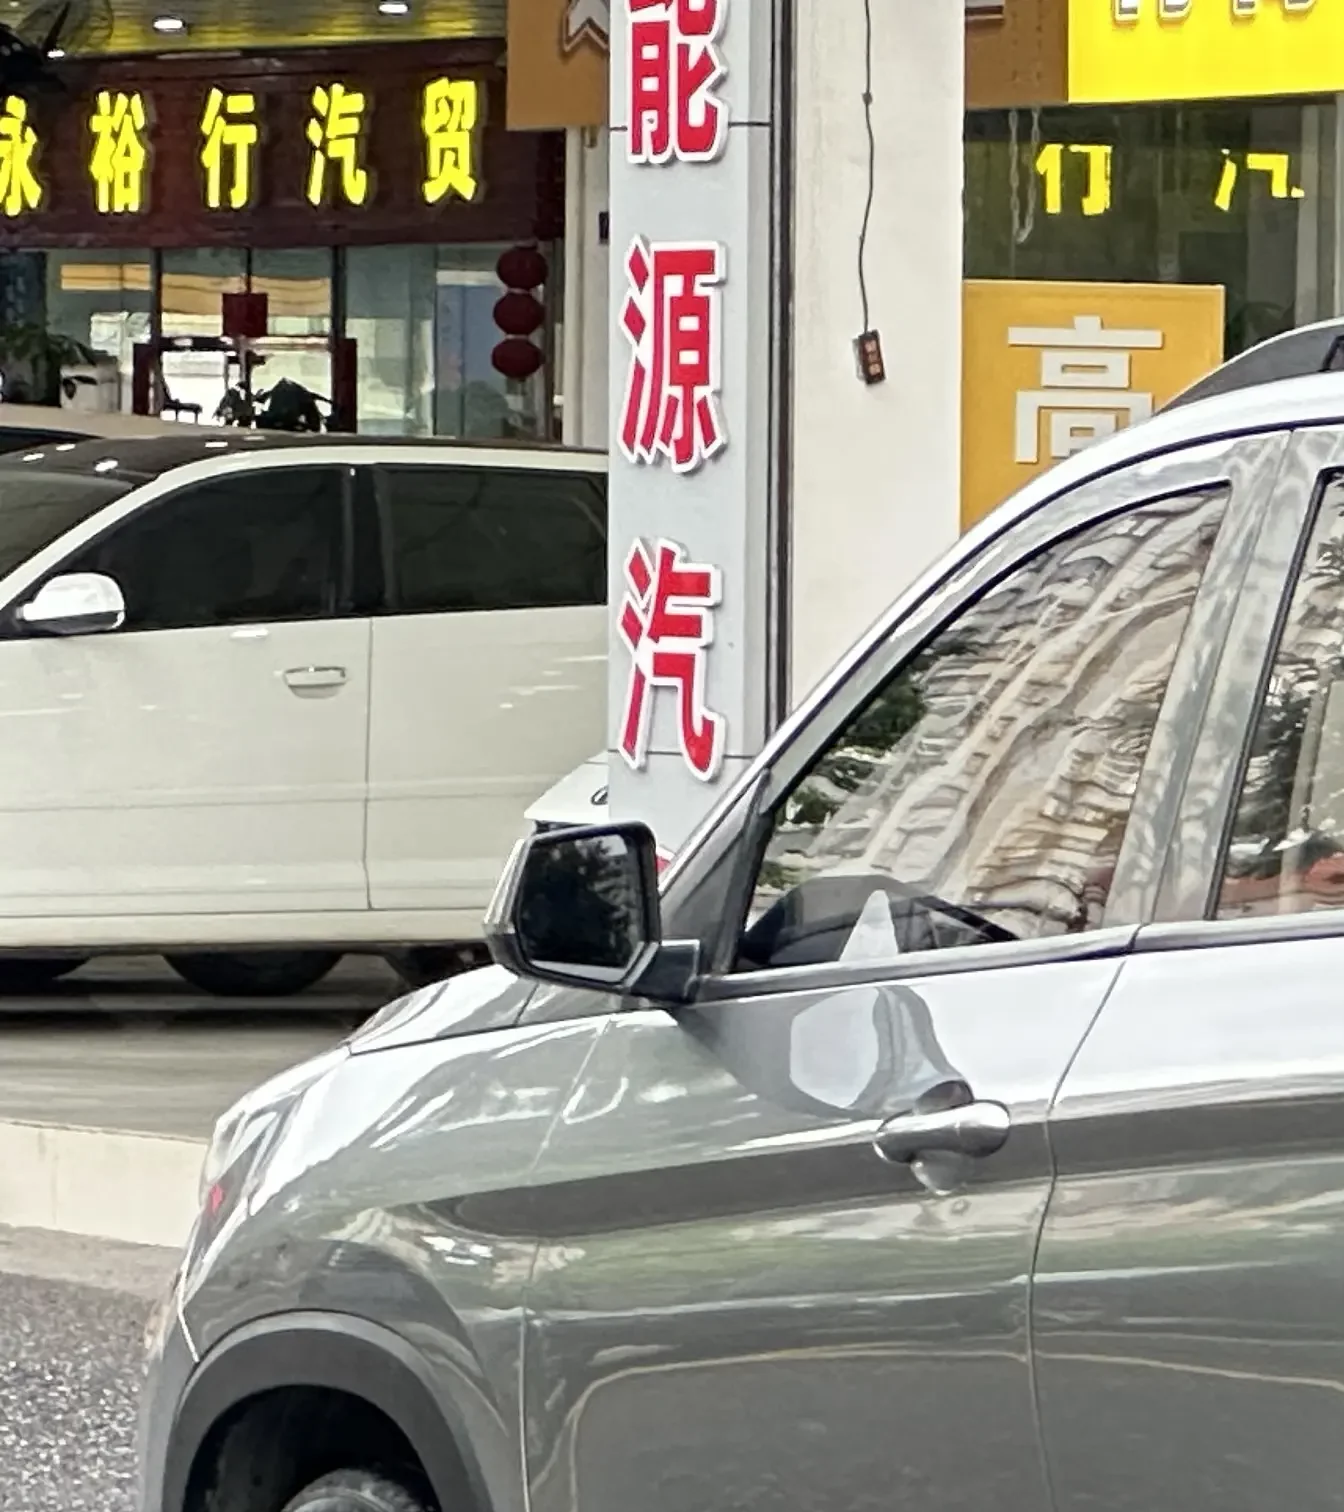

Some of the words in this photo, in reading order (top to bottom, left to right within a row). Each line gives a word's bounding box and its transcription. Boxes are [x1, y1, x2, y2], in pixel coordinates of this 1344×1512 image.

[0, 76, 479, 217] 永裕行汽贸
[618, 0, 731, 782] 能源汽
[1008, 316, 1163, 464] 高
